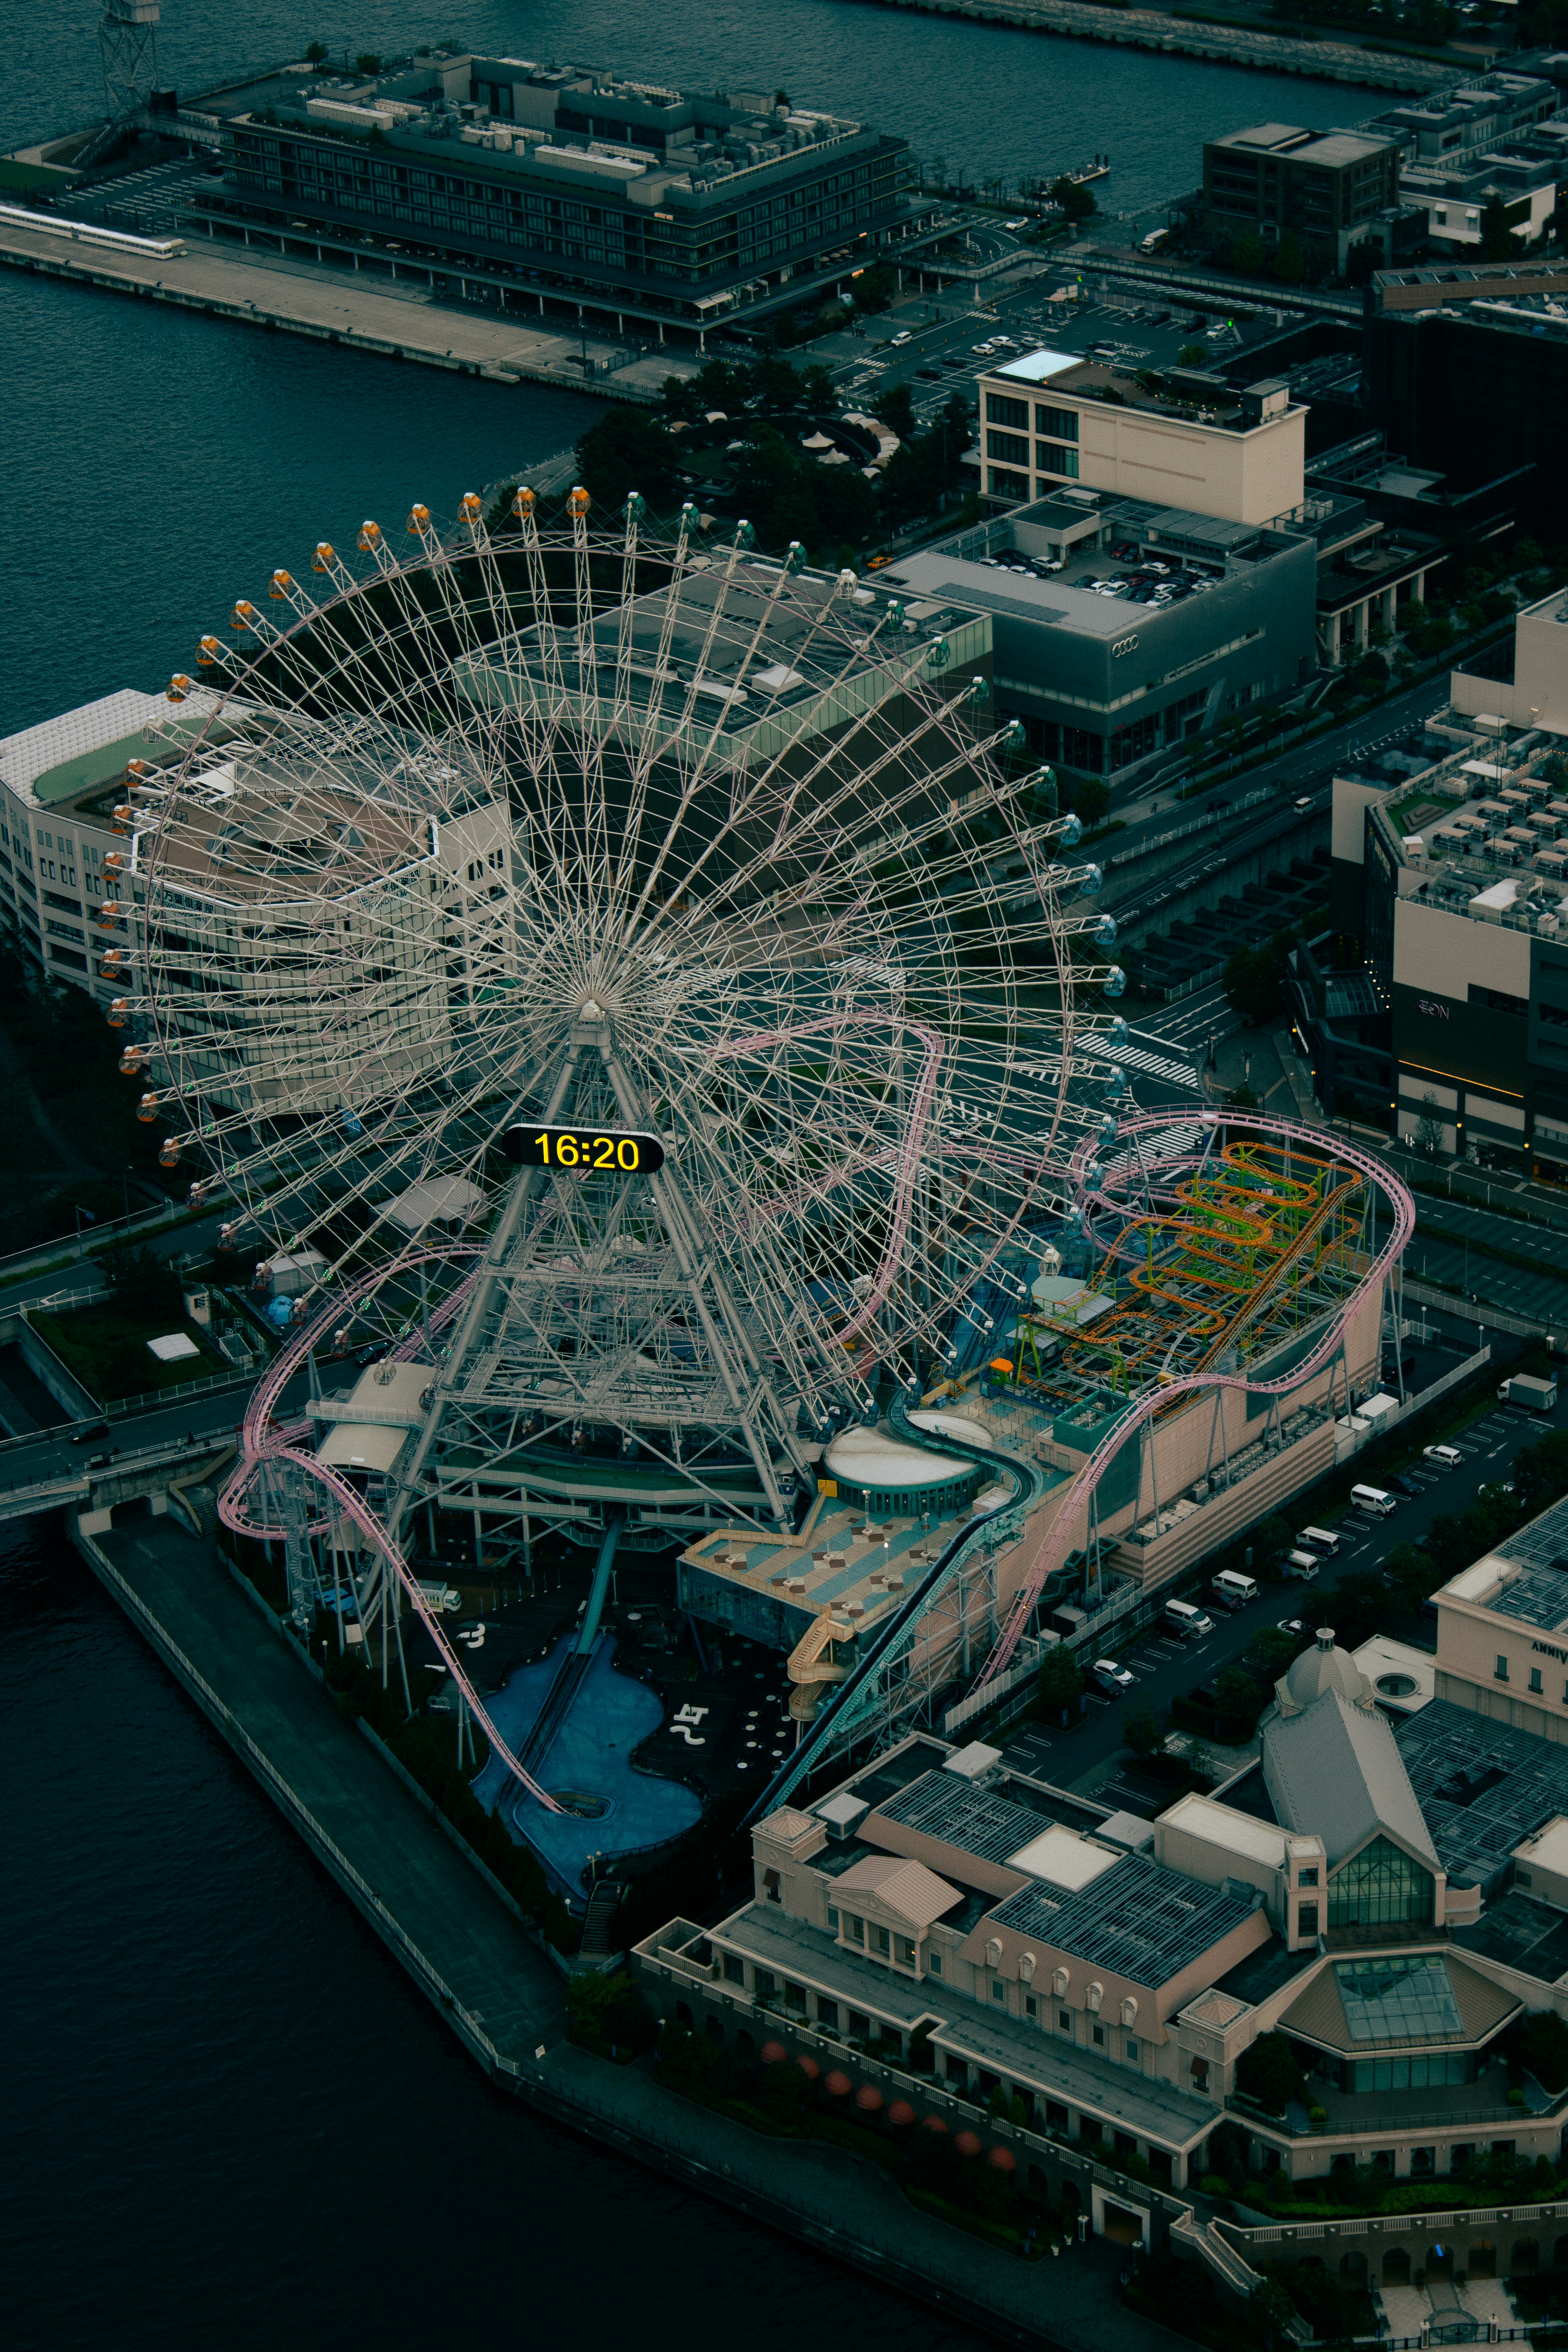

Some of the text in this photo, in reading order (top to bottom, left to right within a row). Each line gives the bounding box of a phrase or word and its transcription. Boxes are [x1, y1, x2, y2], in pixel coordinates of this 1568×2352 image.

[163, 889, 214, 914] 万葉倶楽部
[535, 1133, 639, 1170] 16:20
[1532, 1641, 1568, 1664] ANNIV
